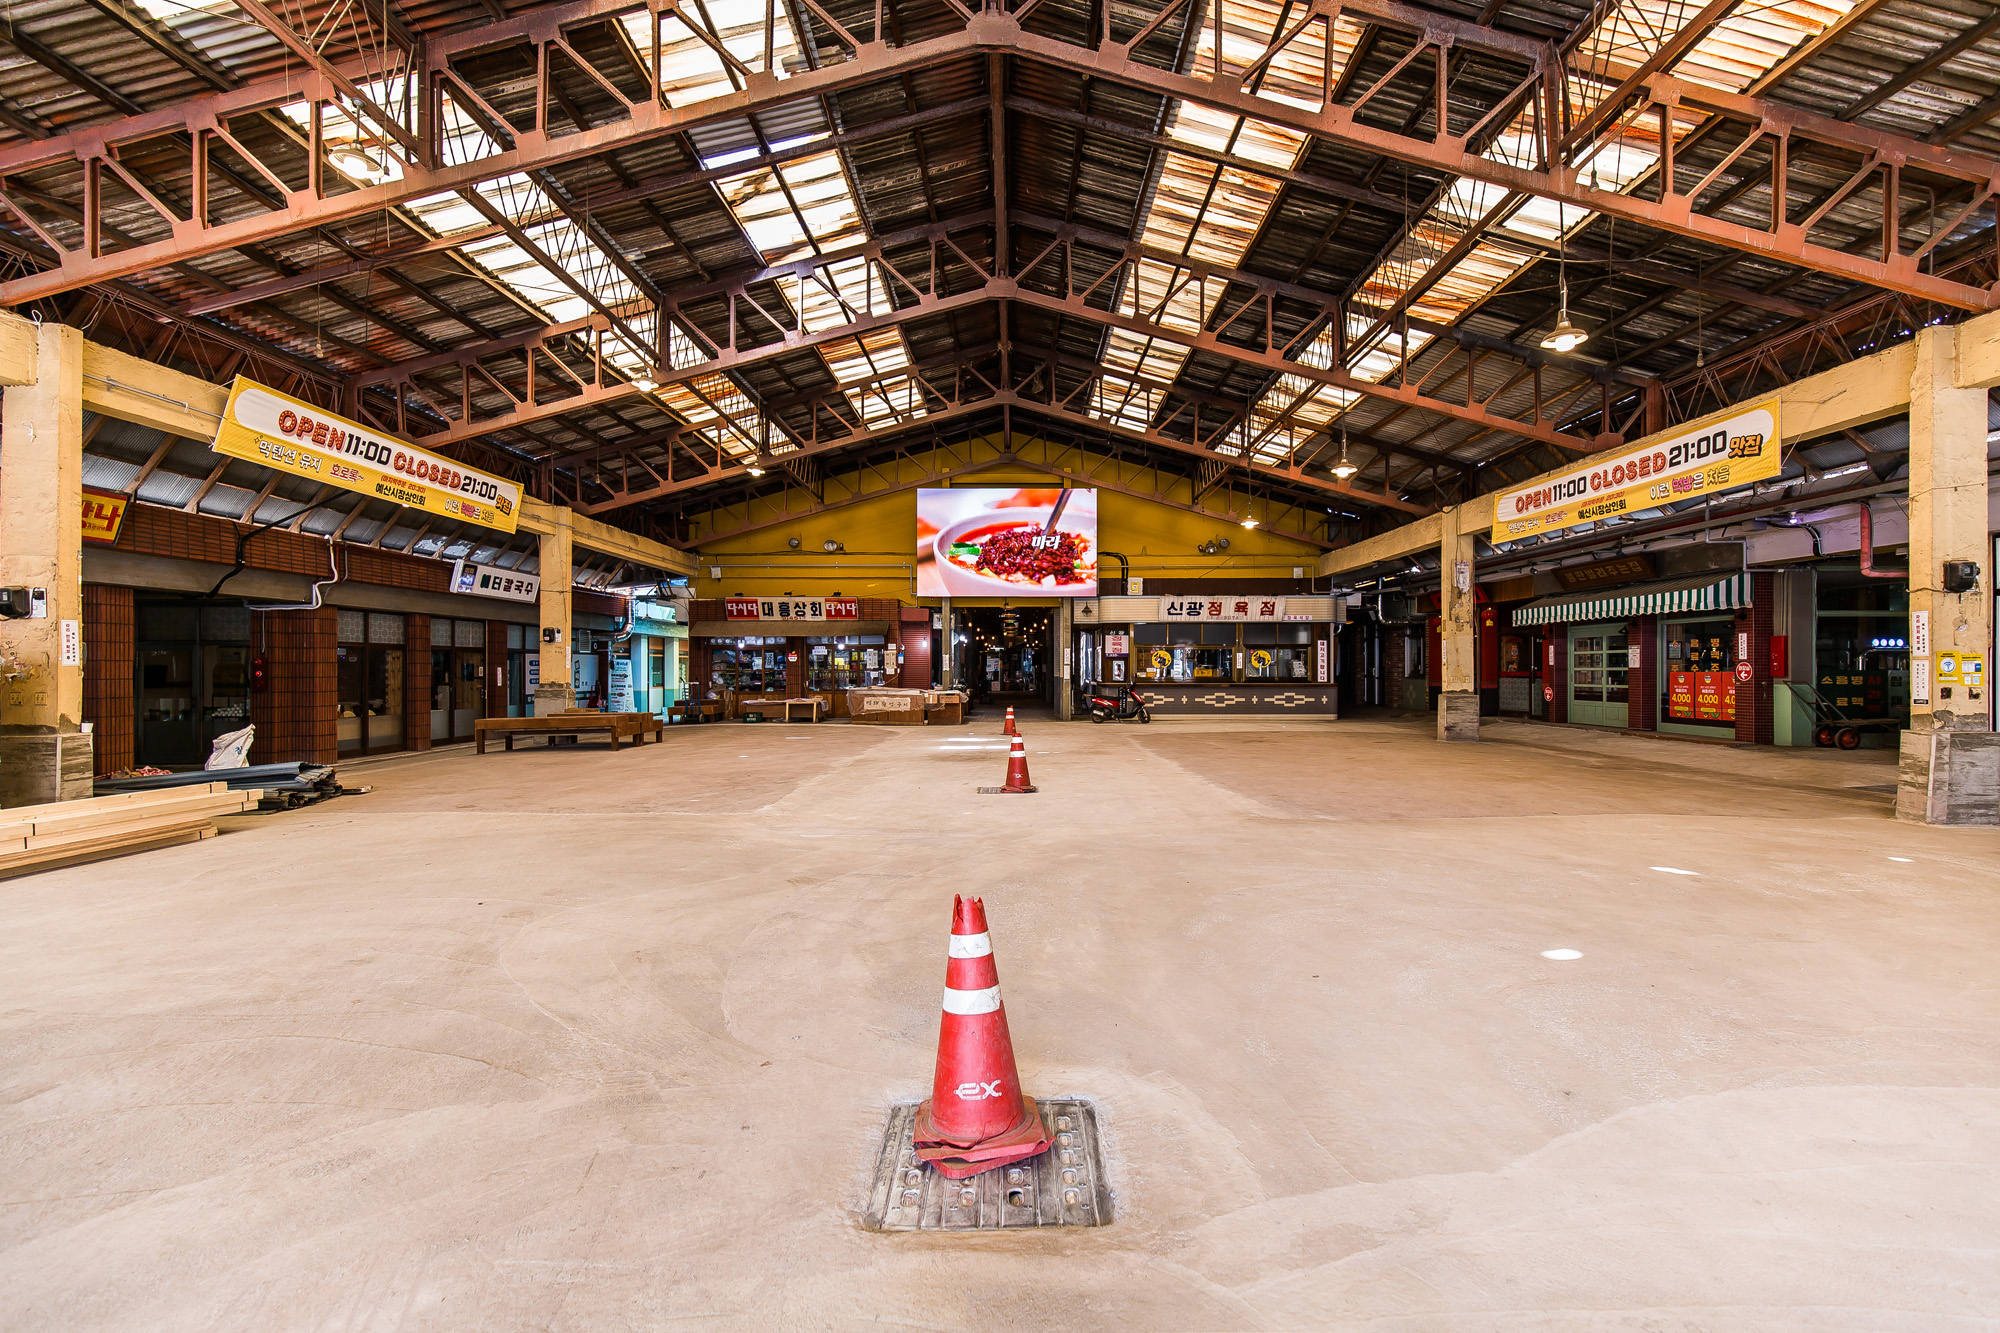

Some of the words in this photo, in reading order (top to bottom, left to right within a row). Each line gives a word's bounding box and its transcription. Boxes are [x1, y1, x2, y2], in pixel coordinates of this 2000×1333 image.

[258, 440, 297, 465] 먹텐션
[299, 453, 323, 473] 유지
[278, 409, 346, 454] OPEN
[345, 434, 392, 466] 11:00
[393, 451, 462, 491] CLOSED
[461, 475, 498, 501] 21:00
[1727, 433, 1764, 459] 맛집
[1515, 488, 1553, 515] OPEN
[1552, 475, 1587, 502] 11:00
[1589, 451, 1669, 492] CLOSED
[1668, 429, 1727, 468] 21:00
[1650, 481, 1670, 500] 이런
[1672, 471, 1704, 495] 먹방은
[1706, 465, 1730, 486] 처음
[375, 482, 427, 506] 예산시장상인회
[445, 497, 460, 514] 이런
[1577, 498, 1627, 520] 예산시장상인회
[727, 602, 758, 616] 다시다
[761, 601, 823, 617] 대흥상회
[825, 602, 857, 616] 다시다
[1166, 601, 1204, 617] 신광
